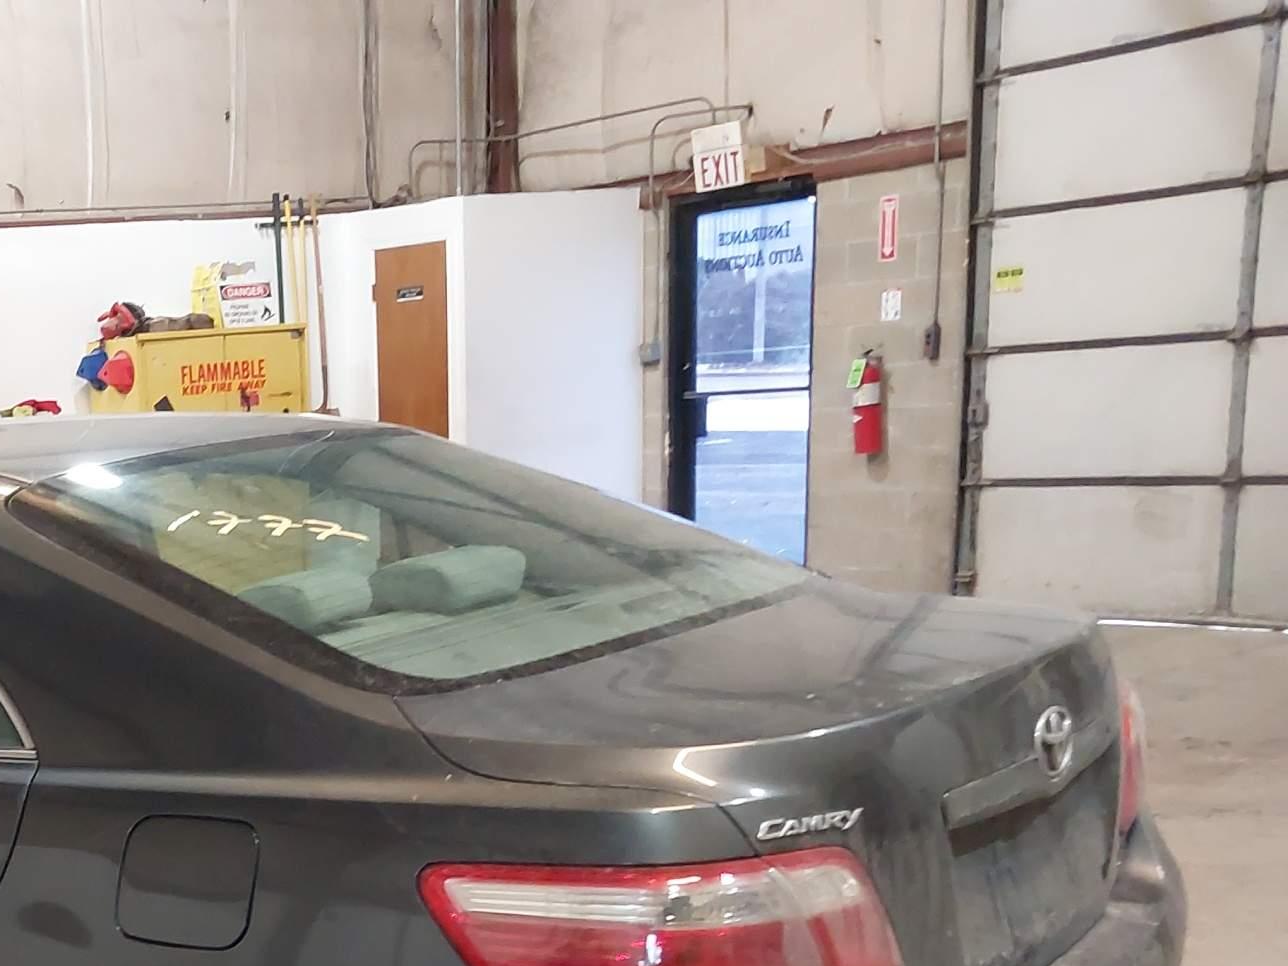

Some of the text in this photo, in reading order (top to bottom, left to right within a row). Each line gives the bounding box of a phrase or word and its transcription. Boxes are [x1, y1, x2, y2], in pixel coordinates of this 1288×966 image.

[701, 151, 740, 188] EXIT
[226, 285, 264, 297] DANGER
[180, 359, 266, 384] FLAMMABLE
[182, 379, 266, 396] KEEP FIRE AWAY
[168, 510, 370, 540] 1777
[756, 807, 865, 841] CAMRY
